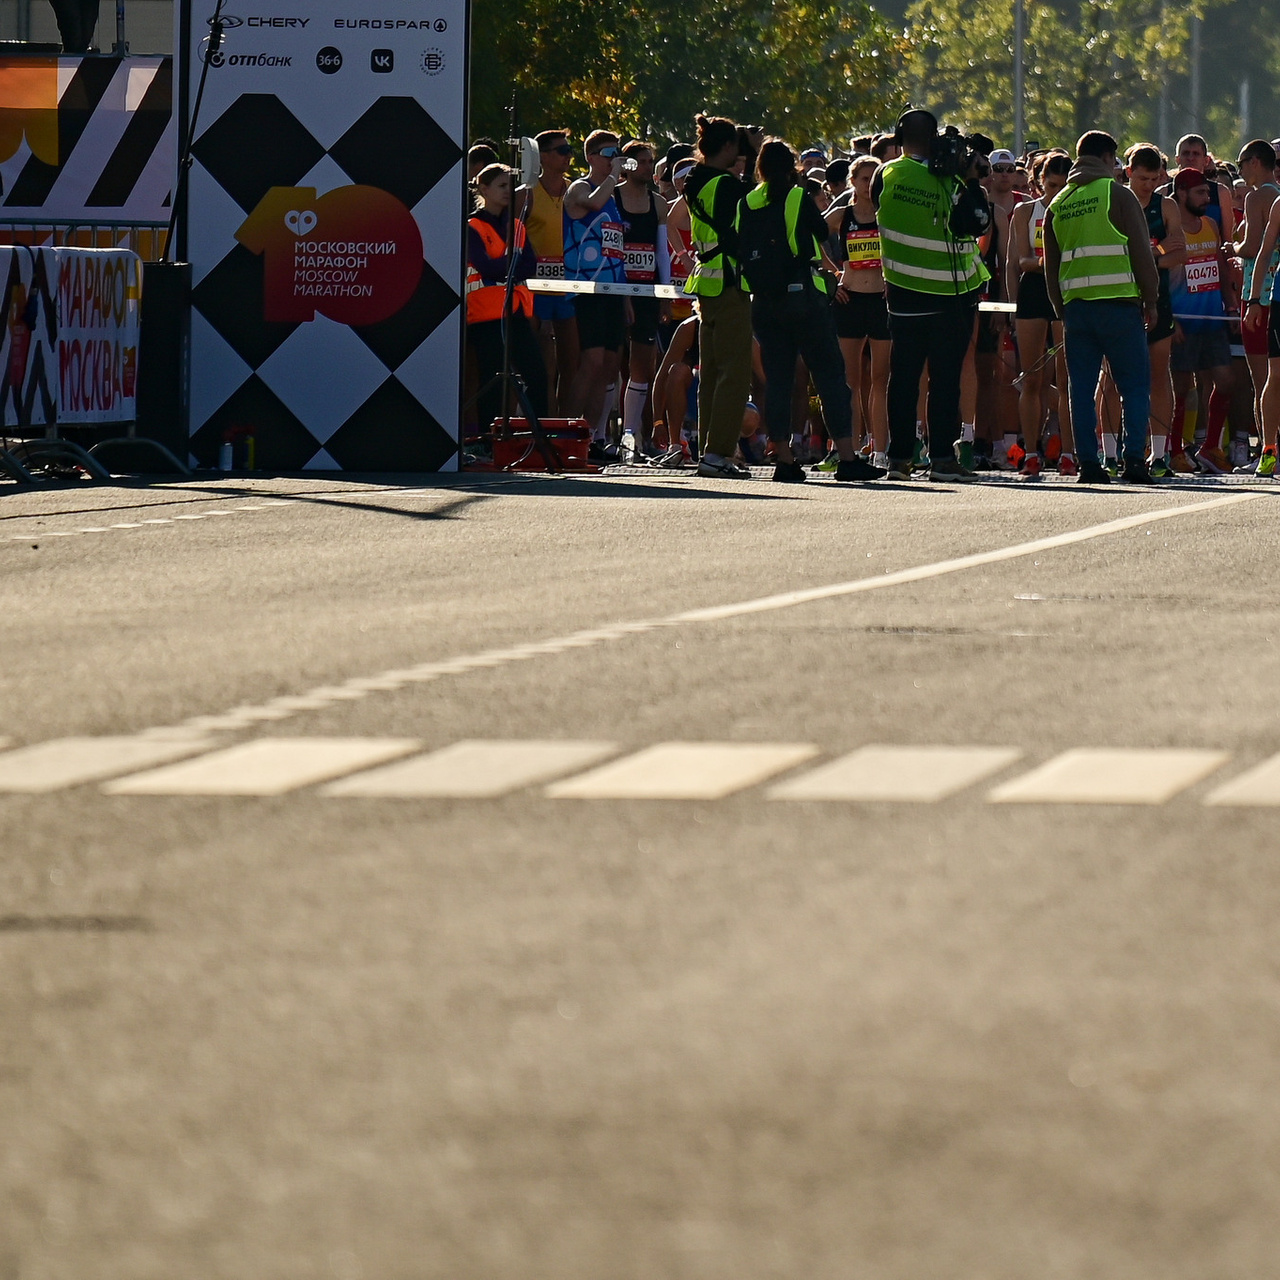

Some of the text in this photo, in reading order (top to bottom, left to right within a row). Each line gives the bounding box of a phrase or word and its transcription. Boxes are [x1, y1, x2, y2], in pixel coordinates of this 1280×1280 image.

[247, 17, 310, 28] CHERY
[334, 19, 430, 30] EUROSPAR
[893, 193, 936, 210] BROADCAST
[294, 240, 396, 255] МОСКОВСКИЙ
[294, 255, 367, 268] МАРАФОН
[623, 253, 653, 265] 28019
[293, 270, 359, 282] MOSCOW
[1187, 266, 1217, 280] 40478
[293, 284, 373, 297] MARATHON
[59, 339, 122, 412] МОСКВА
